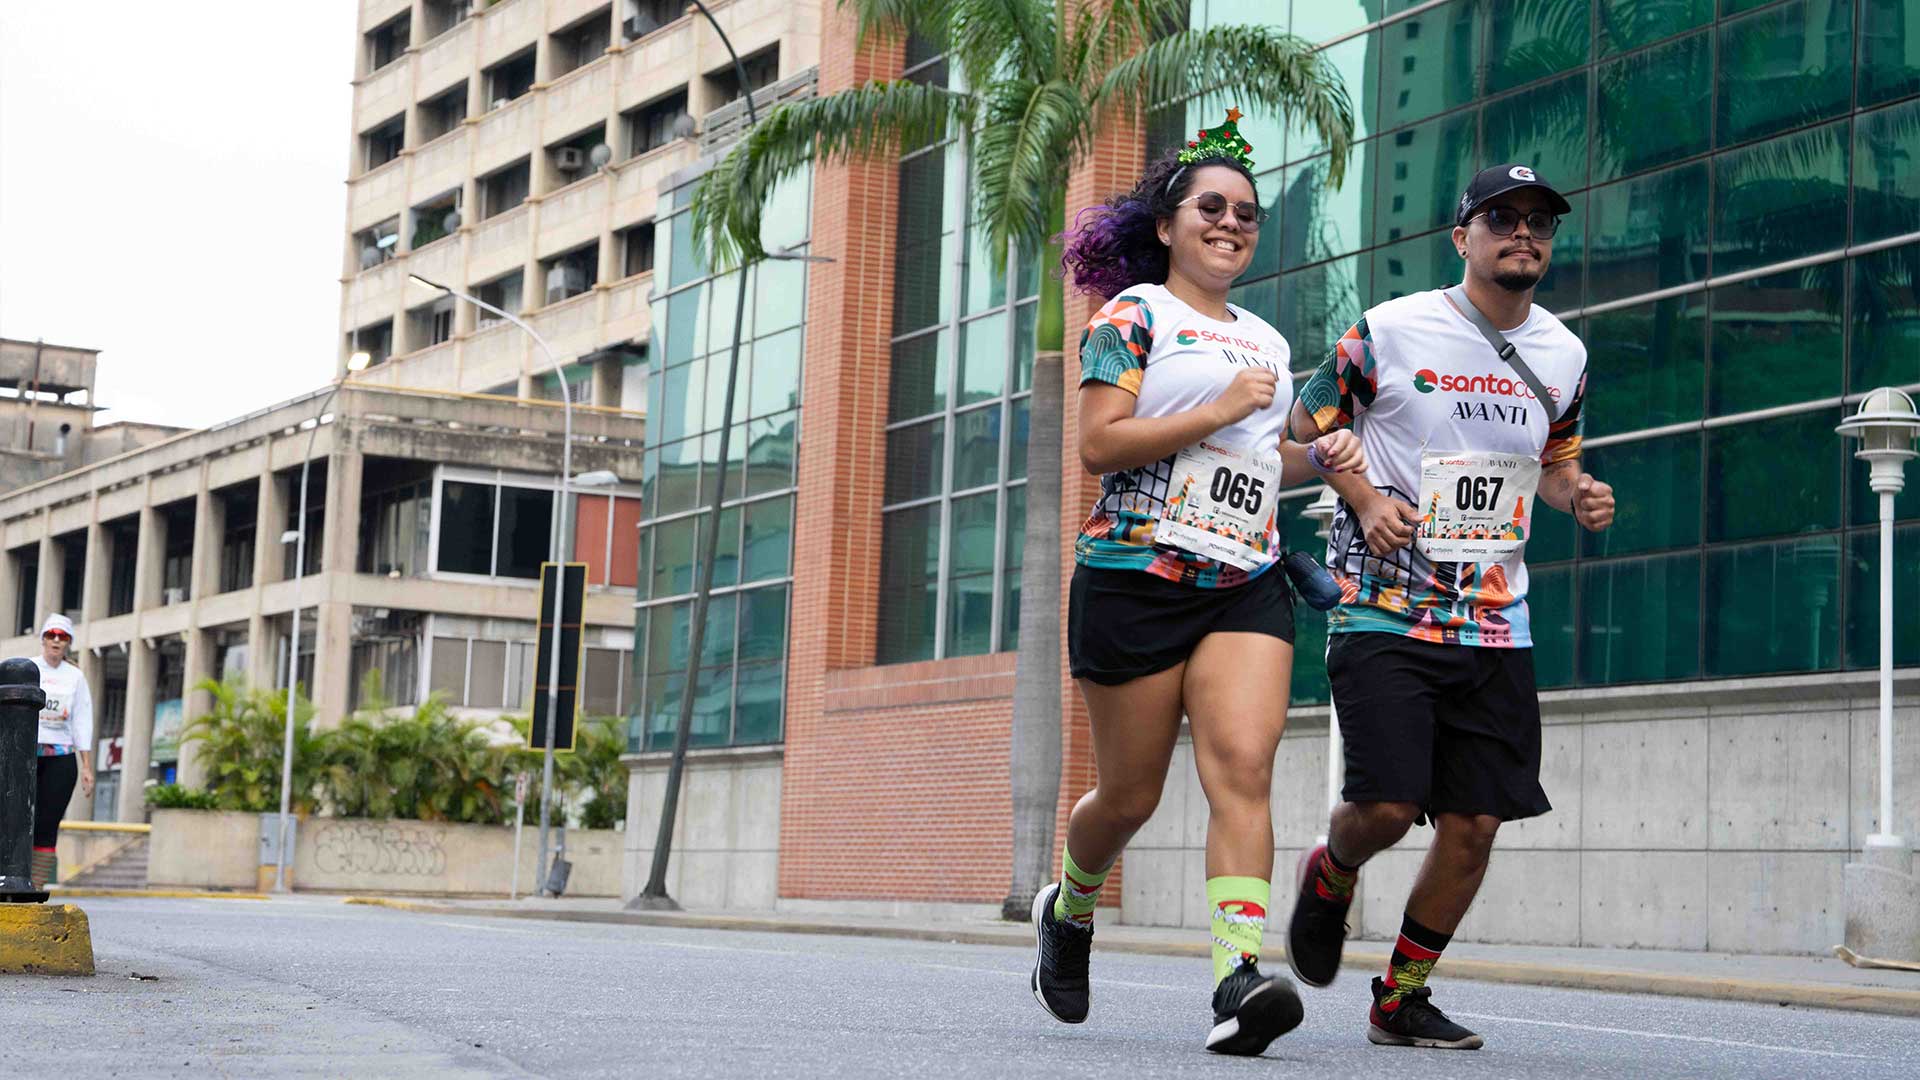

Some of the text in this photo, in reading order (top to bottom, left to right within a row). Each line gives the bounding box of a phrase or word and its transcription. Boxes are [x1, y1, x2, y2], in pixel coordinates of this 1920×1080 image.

[1450, 401, 1527, 425] AVANTI
[1209, 466, 1265, 515] 065
[1455, 475, 1505, 511] 067
[46, 699, 60, 711] 02
